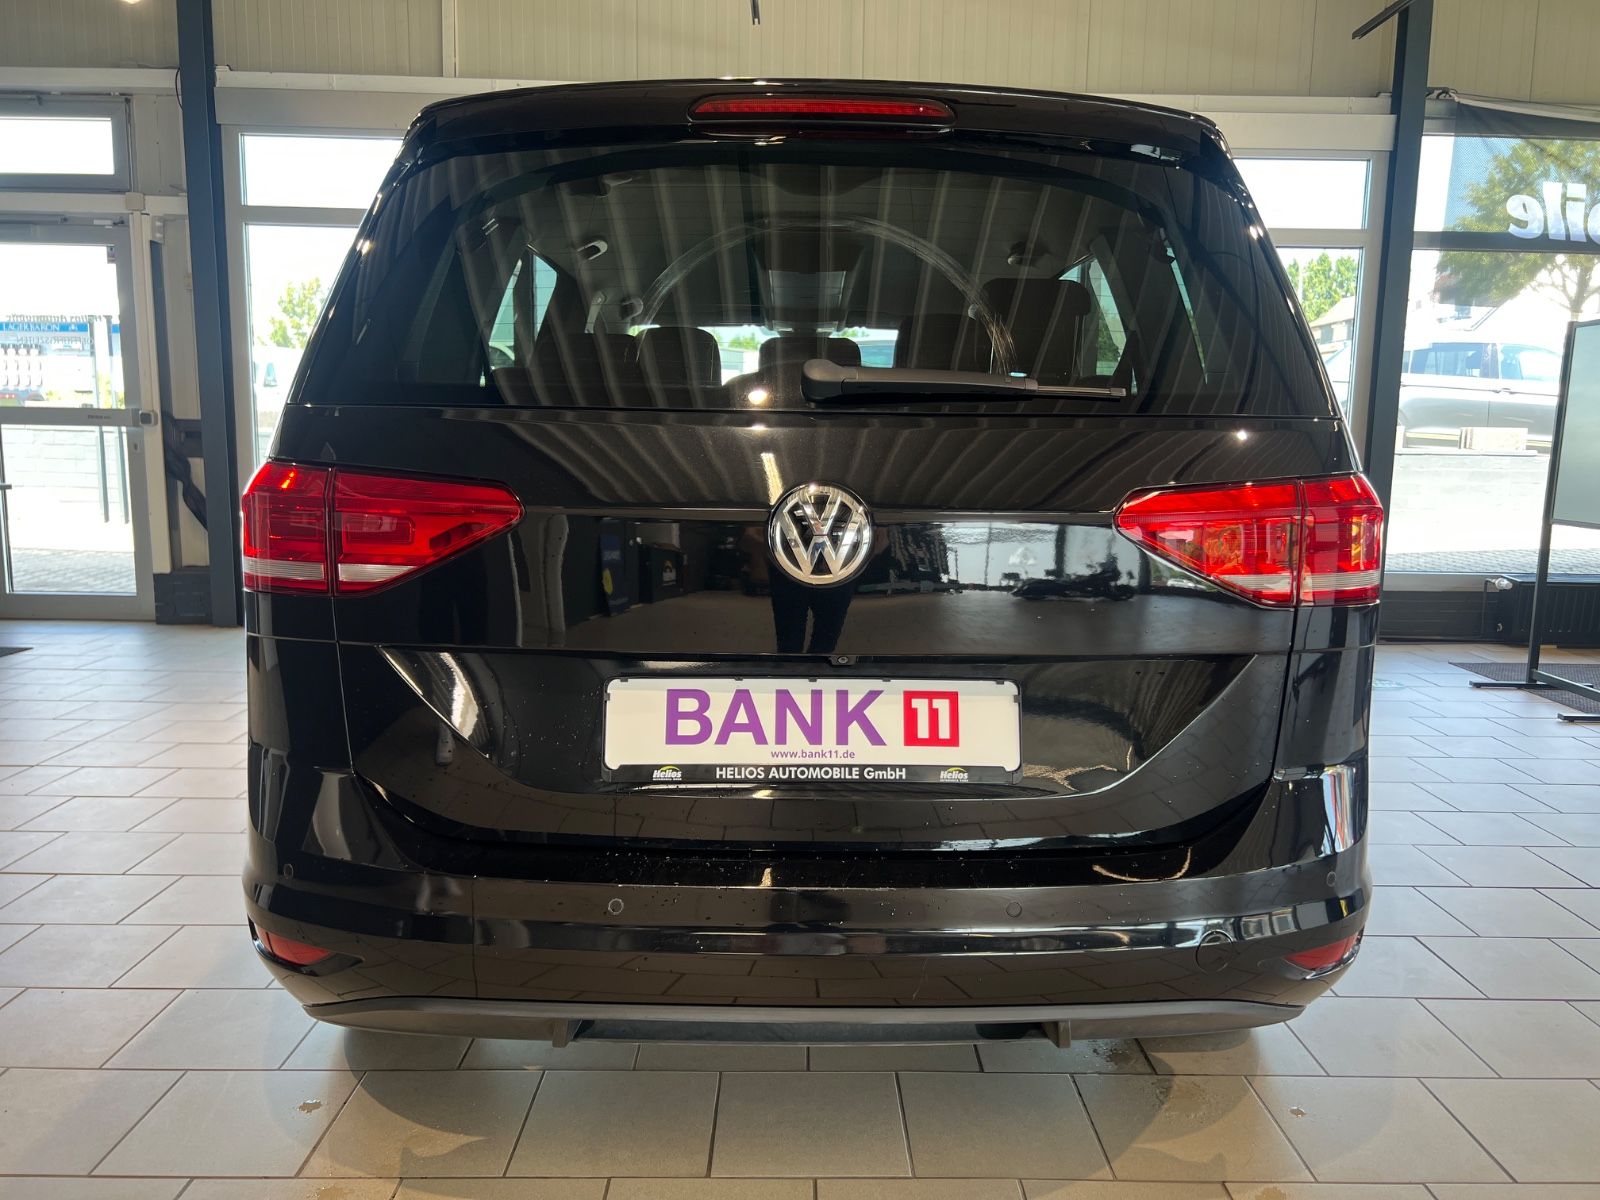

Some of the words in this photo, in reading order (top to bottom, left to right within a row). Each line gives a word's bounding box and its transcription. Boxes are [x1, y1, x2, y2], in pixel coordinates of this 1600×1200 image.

[664, 688, 887, 746] BANK
[909, 695, 953, 742] 11
[770, 749, 856, 760] www.bank11.de
[652, 769, 682, 778] Helios
[715, 766, 765, 780] HELIOS
[768, 766, 860, 780] AUTOMOBILE
[863, 767, 907, 780] GmbH
[939, 770, 969, 779] Helios
